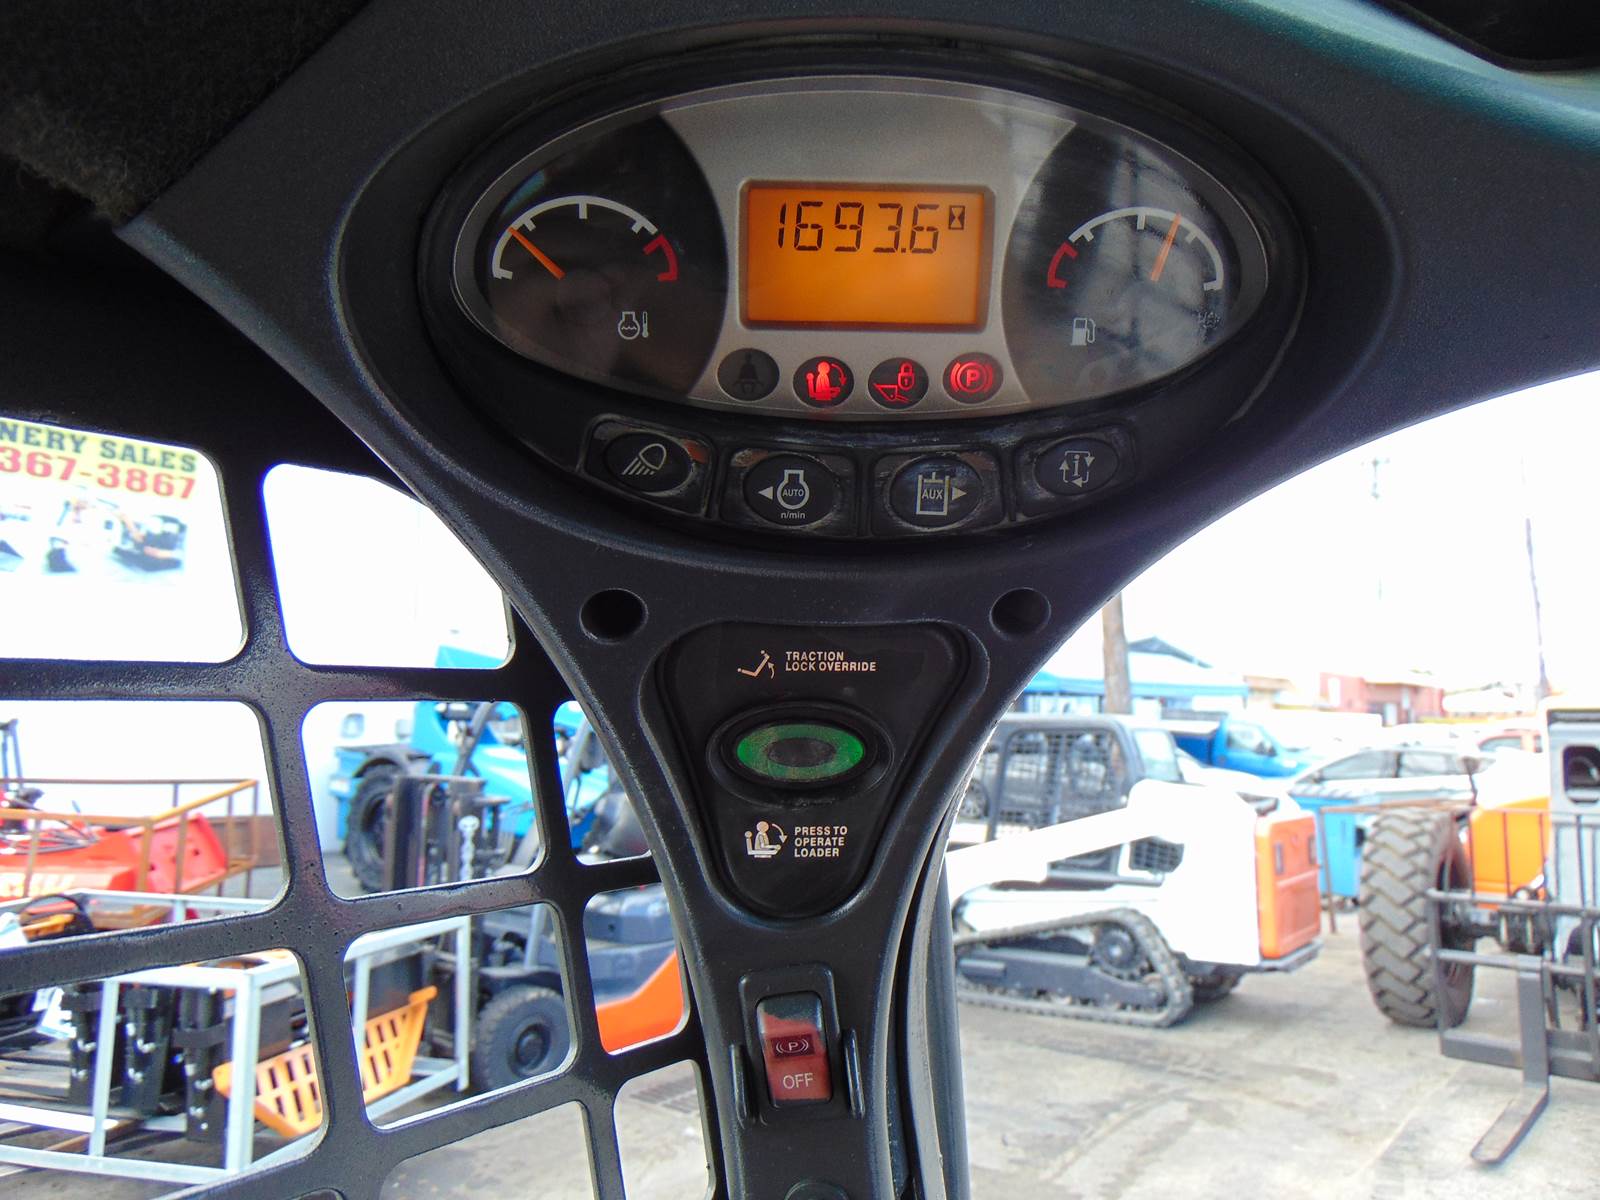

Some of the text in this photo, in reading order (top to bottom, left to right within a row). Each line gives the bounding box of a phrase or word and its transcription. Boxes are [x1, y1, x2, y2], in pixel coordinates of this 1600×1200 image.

[777, 201, 940, 254] 1693.6
[0, 421, 197, 473] NERY SALES
[0, 446, 197, 500] 367-3867
[782, 487, 805, 498] AUTO
[922, 488, 944, 500] AUX
[780, 510, 806, 520] n/min
[785, 651, 844, 662] TRACTION
[785, 661, 877, 672] LOCK OVERRIDE
[794, 825, 848, 836] PRESS TO
[794, 837, 845, 847] OPERATE
[794, 847, 840, 858] LOADER
[783, 1073, 813, 1089] OFF
